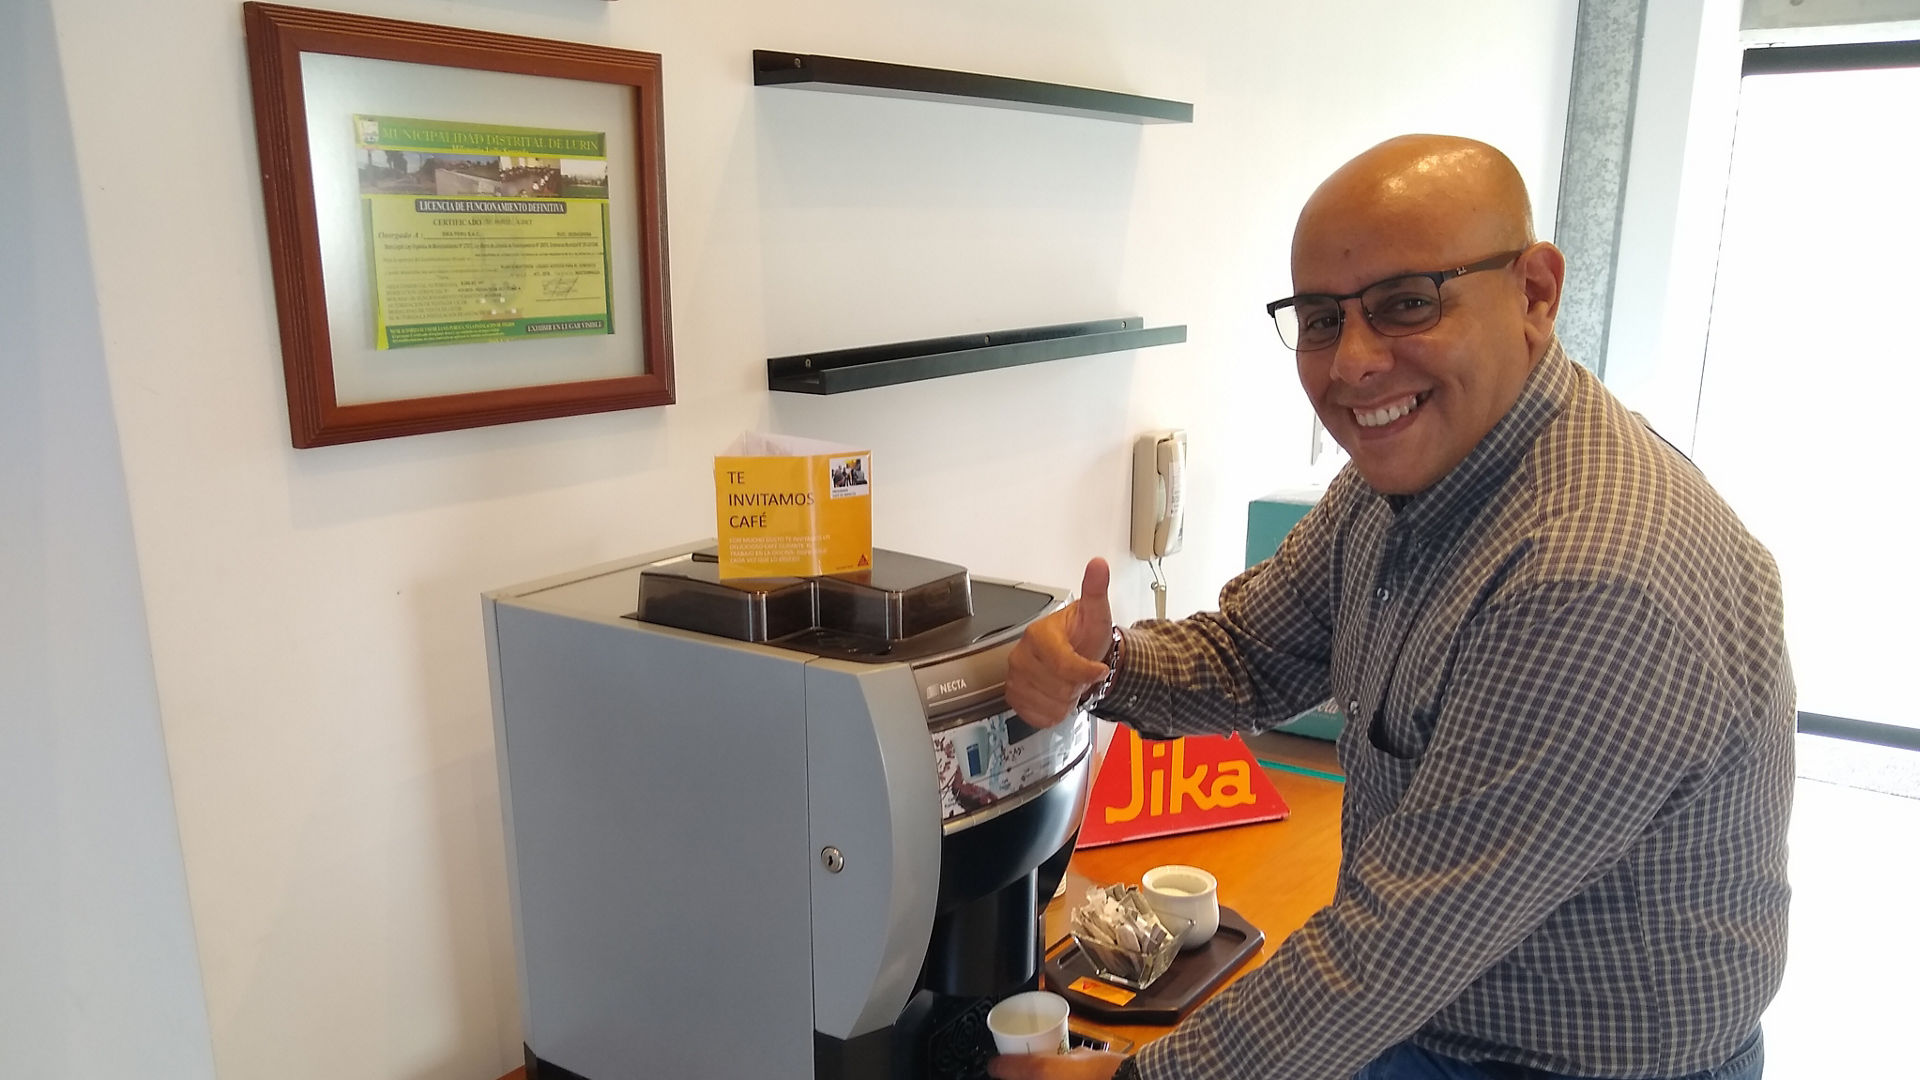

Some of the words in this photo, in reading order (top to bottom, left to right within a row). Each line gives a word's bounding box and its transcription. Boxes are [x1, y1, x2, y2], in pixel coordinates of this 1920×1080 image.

[382, 127, 485, 145] MUNICIPALIDAD
[487, 134, 545, 149] DISTRITAL
[419, 200, 455, 211] LICENCIA
[455, 201, 465, 211] DE
[466, 201, 527, 212] FUNCIONAMIENTO
[528, 202, 565, 213] DEFINITIVA
[727, 471, 745, 485] TE
[728, 492, 815, 507] INVITAMOS
[729, 511, 768, 529] CAFÉ
[940, 679, 967, 695] NECTA
